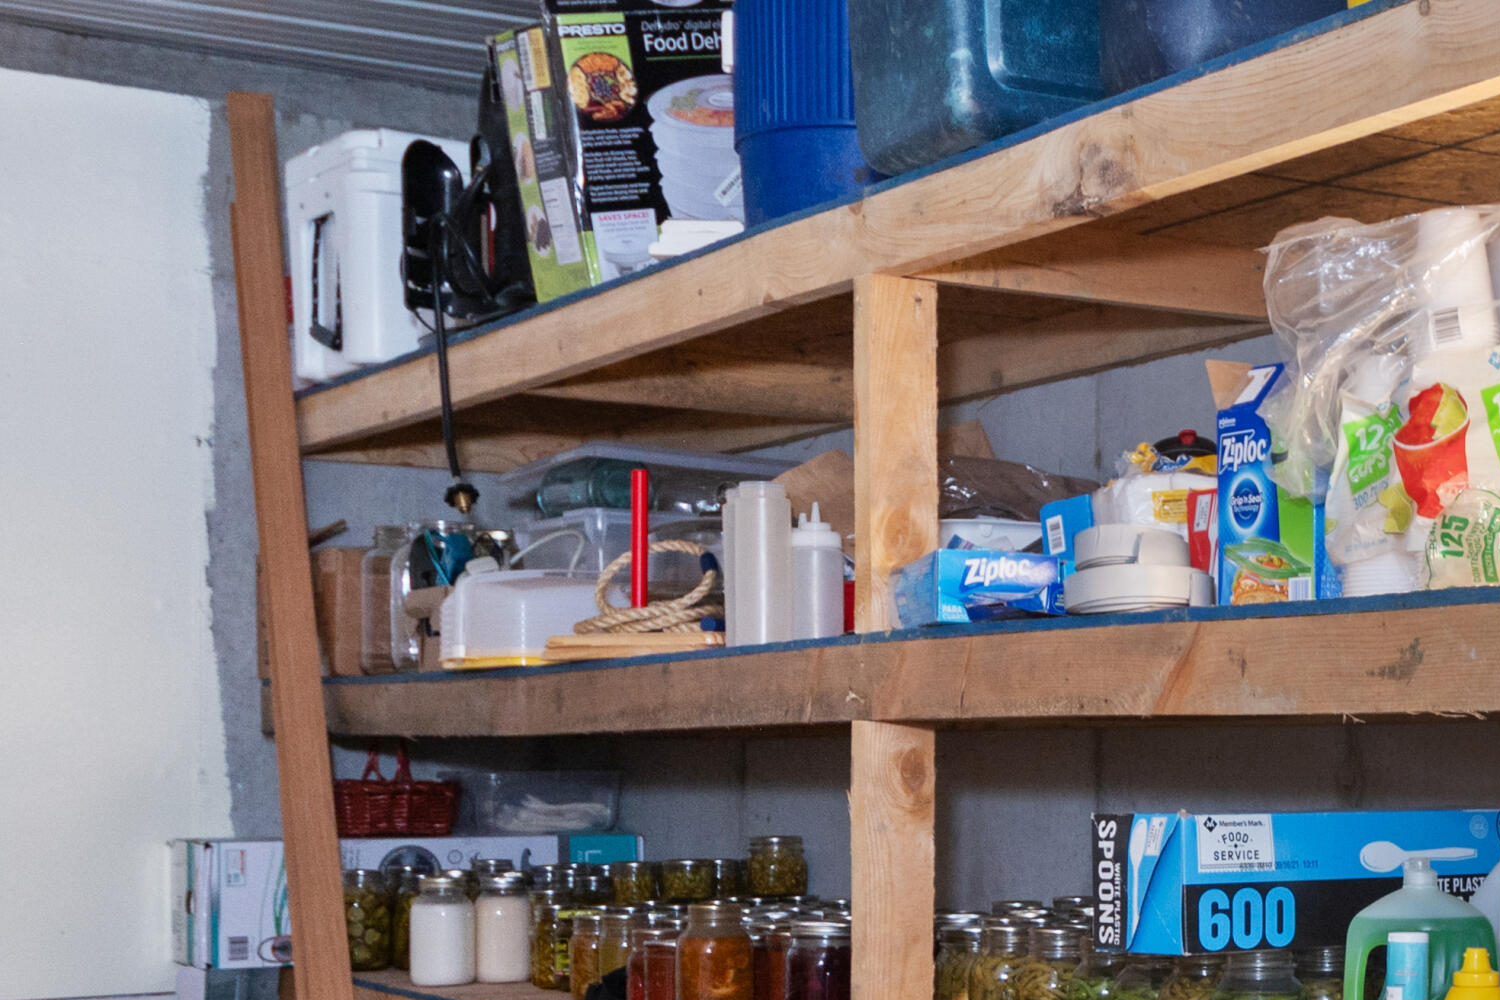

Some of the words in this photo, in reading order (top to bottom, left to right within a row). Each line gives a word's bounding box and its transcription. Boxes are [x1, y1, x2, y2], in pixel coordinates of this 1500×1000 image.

[557, 23, 626, 37] PRESTO
[681, 19, 710, 32] digital
[643, 33, 688, 52] Food
[1355, 423, 1384, 452] 12
[1222, 436, 1268, 473] Ziploc
[1440, 515, 1470, 560] 125
[964, 556, 1031, 588] Ziploc
[1218, 819, 1247, 828] Member's
[1221, 831, 1250, 845] FOOD
[1213, 850, 1261, 862] SERVICE
[1097, 818, 1117, 946] SPOONS
[1114, 861, 1122, 898] WHITE
[1113, 899, 1122, 947] PLASTIC
[1198, 886, 1297, 953] 600
